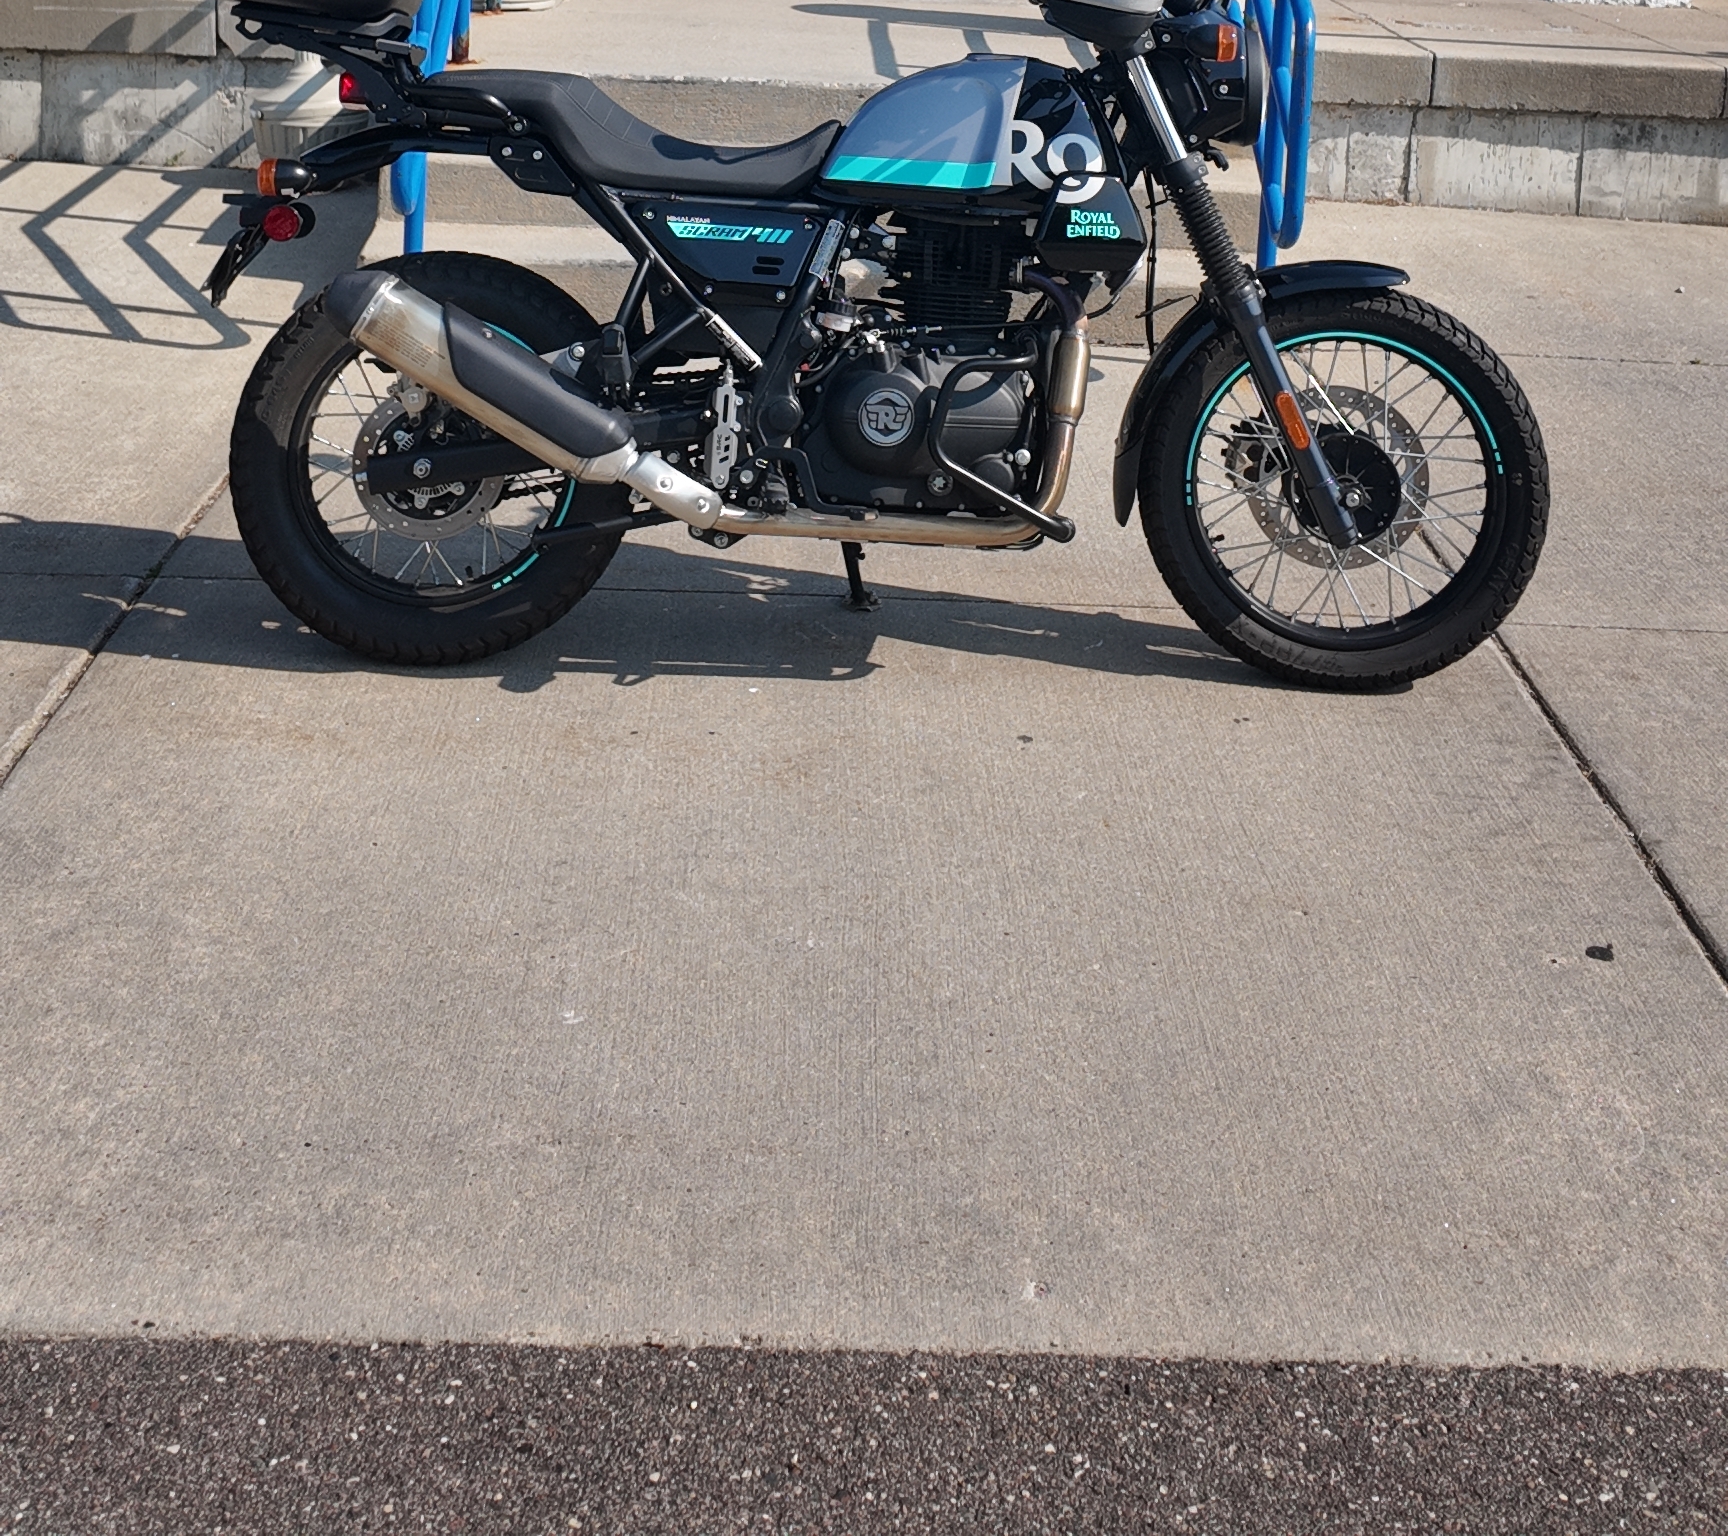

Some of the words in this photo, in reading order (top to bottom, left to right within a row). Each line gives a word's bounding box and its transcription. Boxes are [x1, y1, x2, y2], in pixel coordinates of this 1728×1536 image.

[666, 215, 711, 224] HIMALAYAN
[1070, 209, 1115, 225] ROYAL
[679, 225, 749, 239] SCRAM
[1066, 224, 1121, 239] ENFIELD
